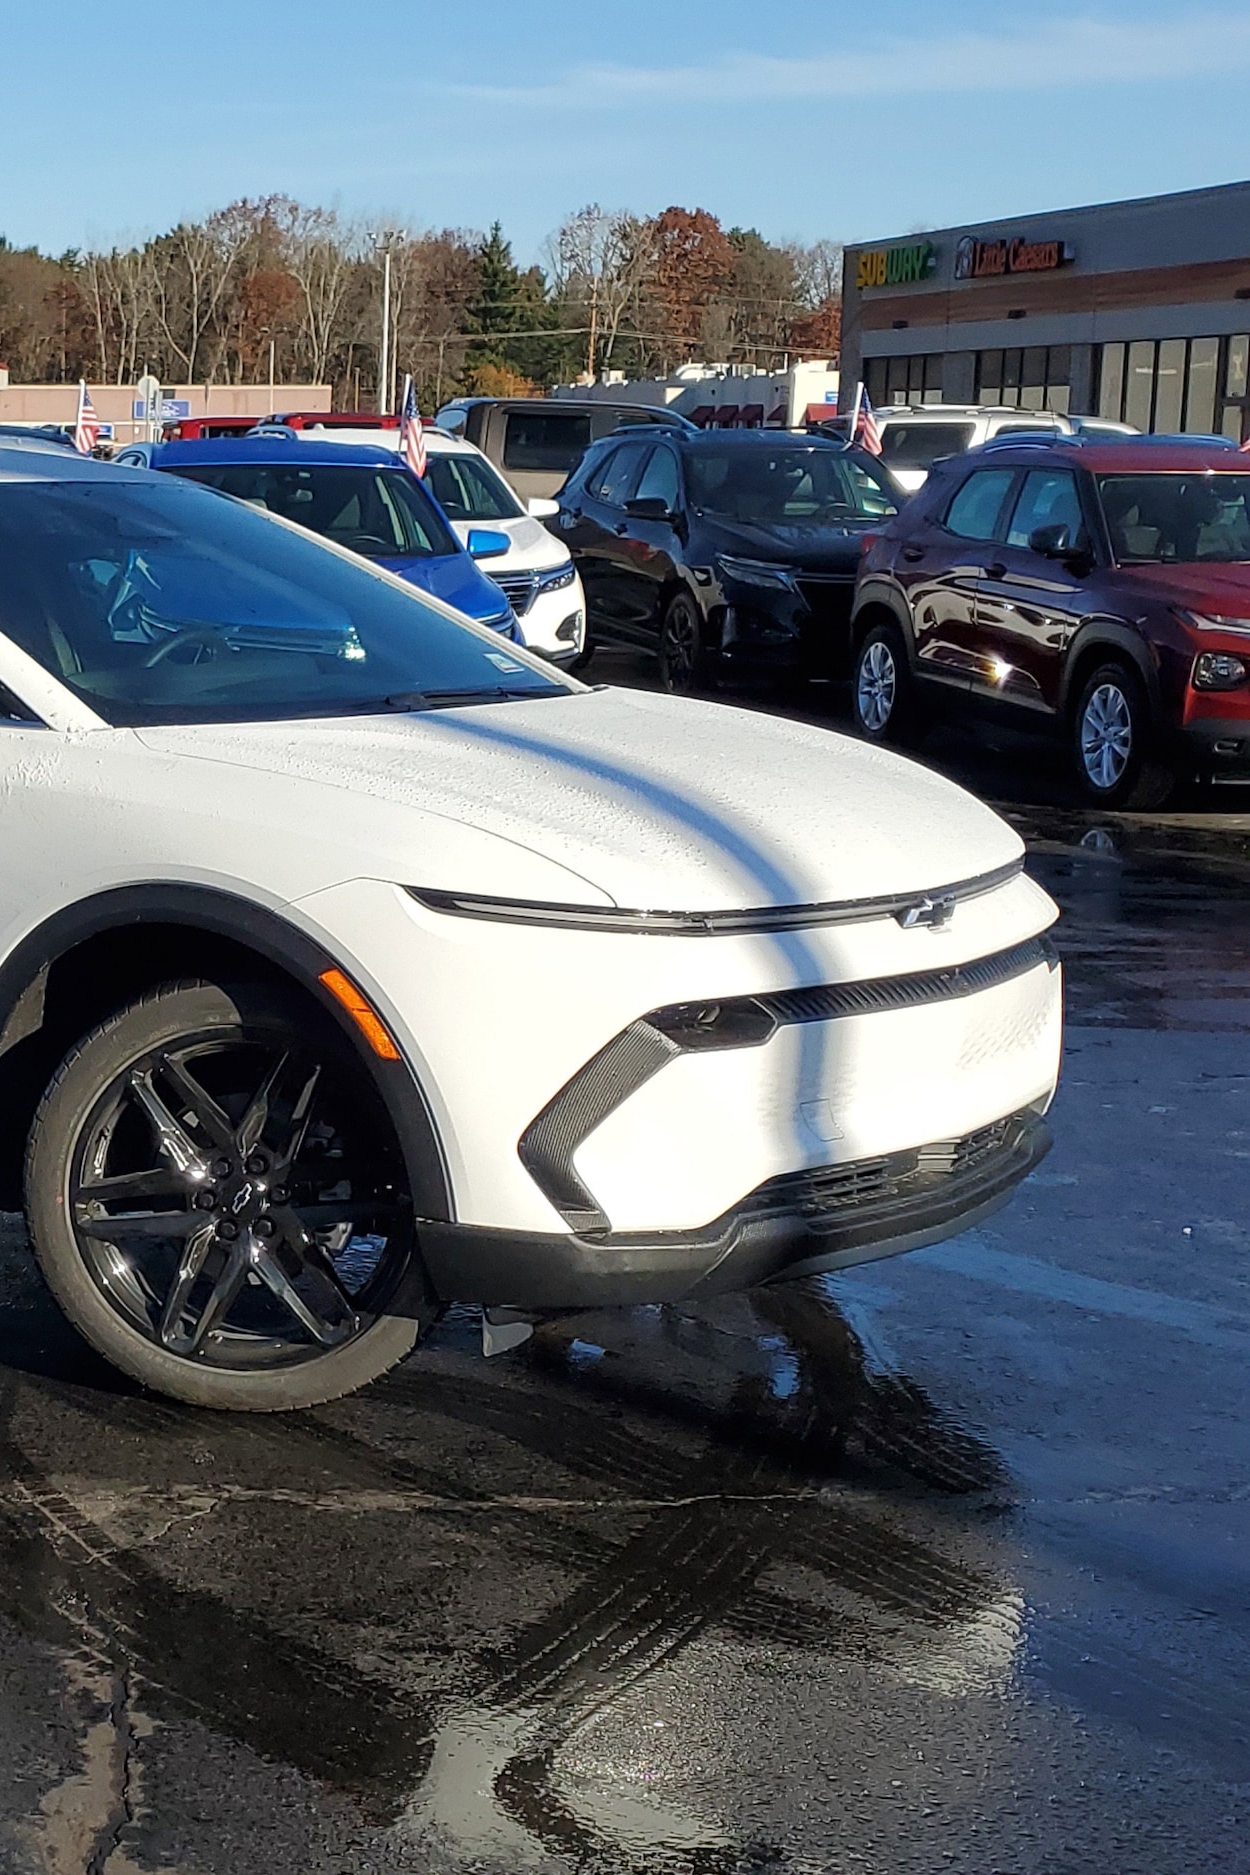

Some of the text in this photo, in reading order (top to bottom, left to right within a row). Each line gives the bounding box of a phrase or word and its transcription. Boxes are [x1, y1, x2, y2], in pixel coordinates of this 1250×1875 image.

[856, 242, 933, 288] SUBWAY
[975, 237, 1061, 276] Little Caesars
